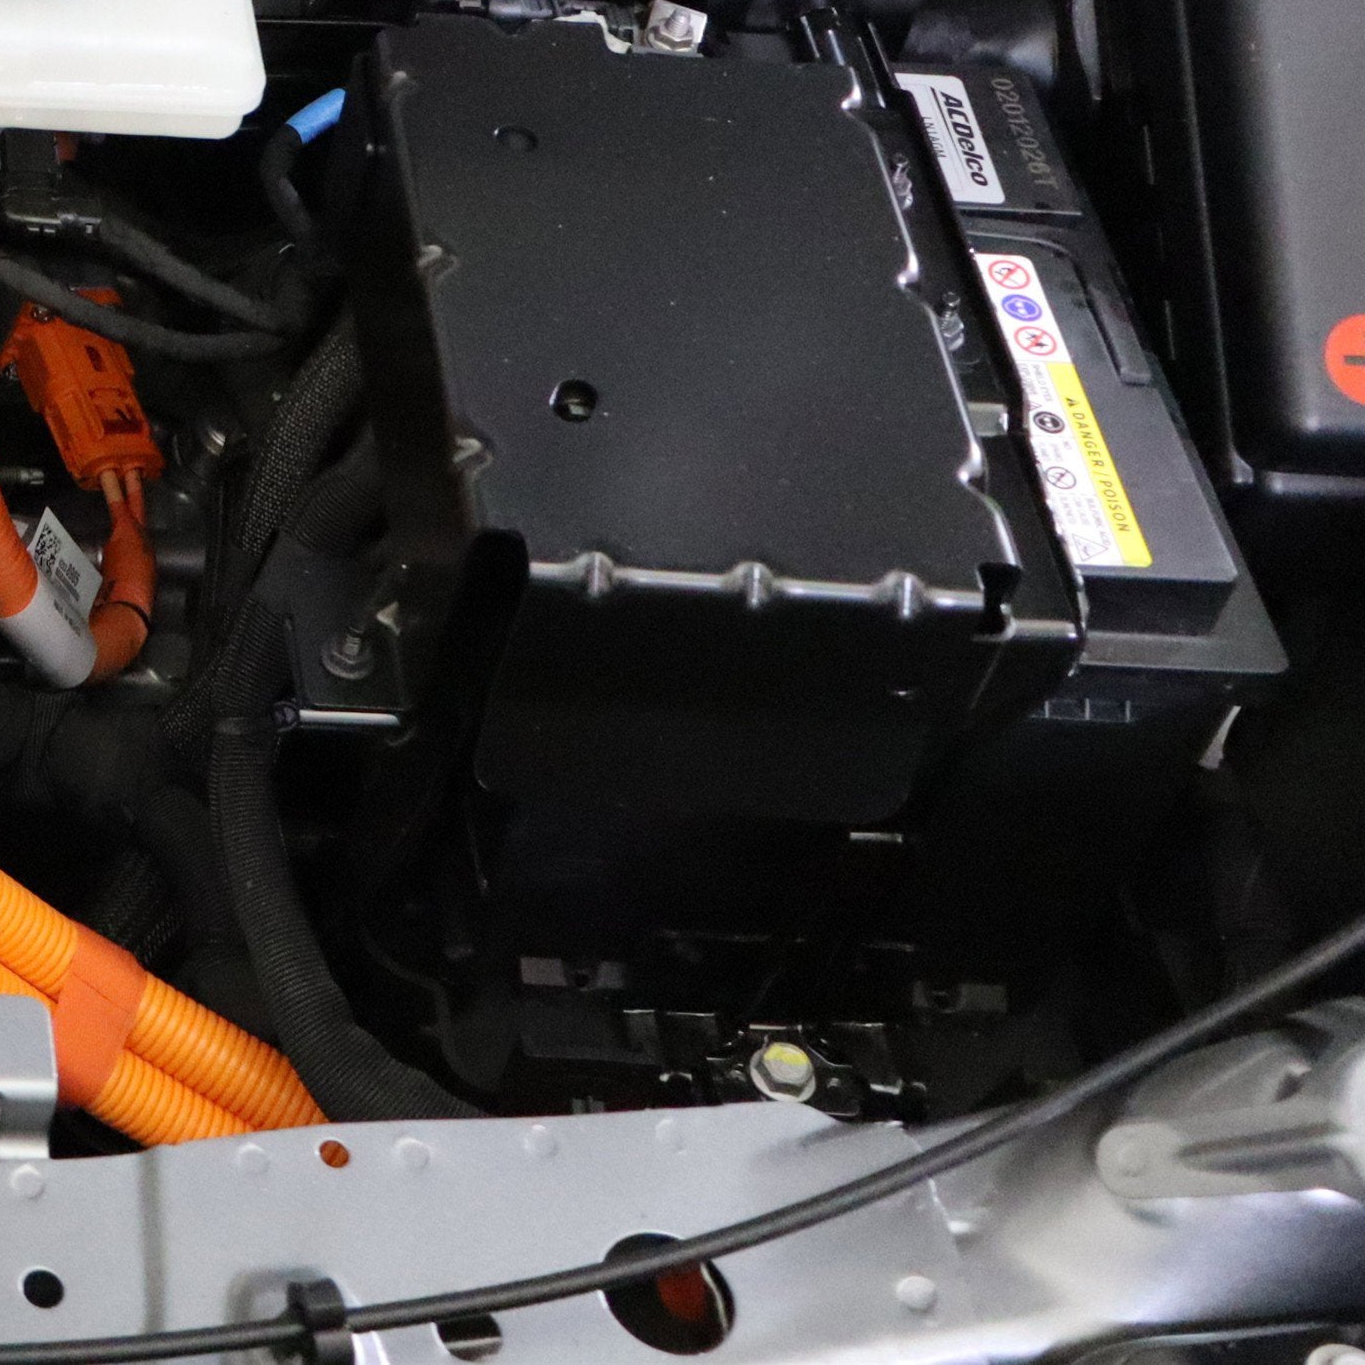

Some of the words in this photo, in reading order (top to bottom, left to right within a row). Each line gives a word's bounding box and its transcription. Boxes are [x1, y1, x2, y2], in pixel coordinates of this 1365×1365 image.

[939, 91, 989, 187] ACDelco
[1073, 412, 1105, 467] DANGER
[1099, 480, 1130, 532] POISON
